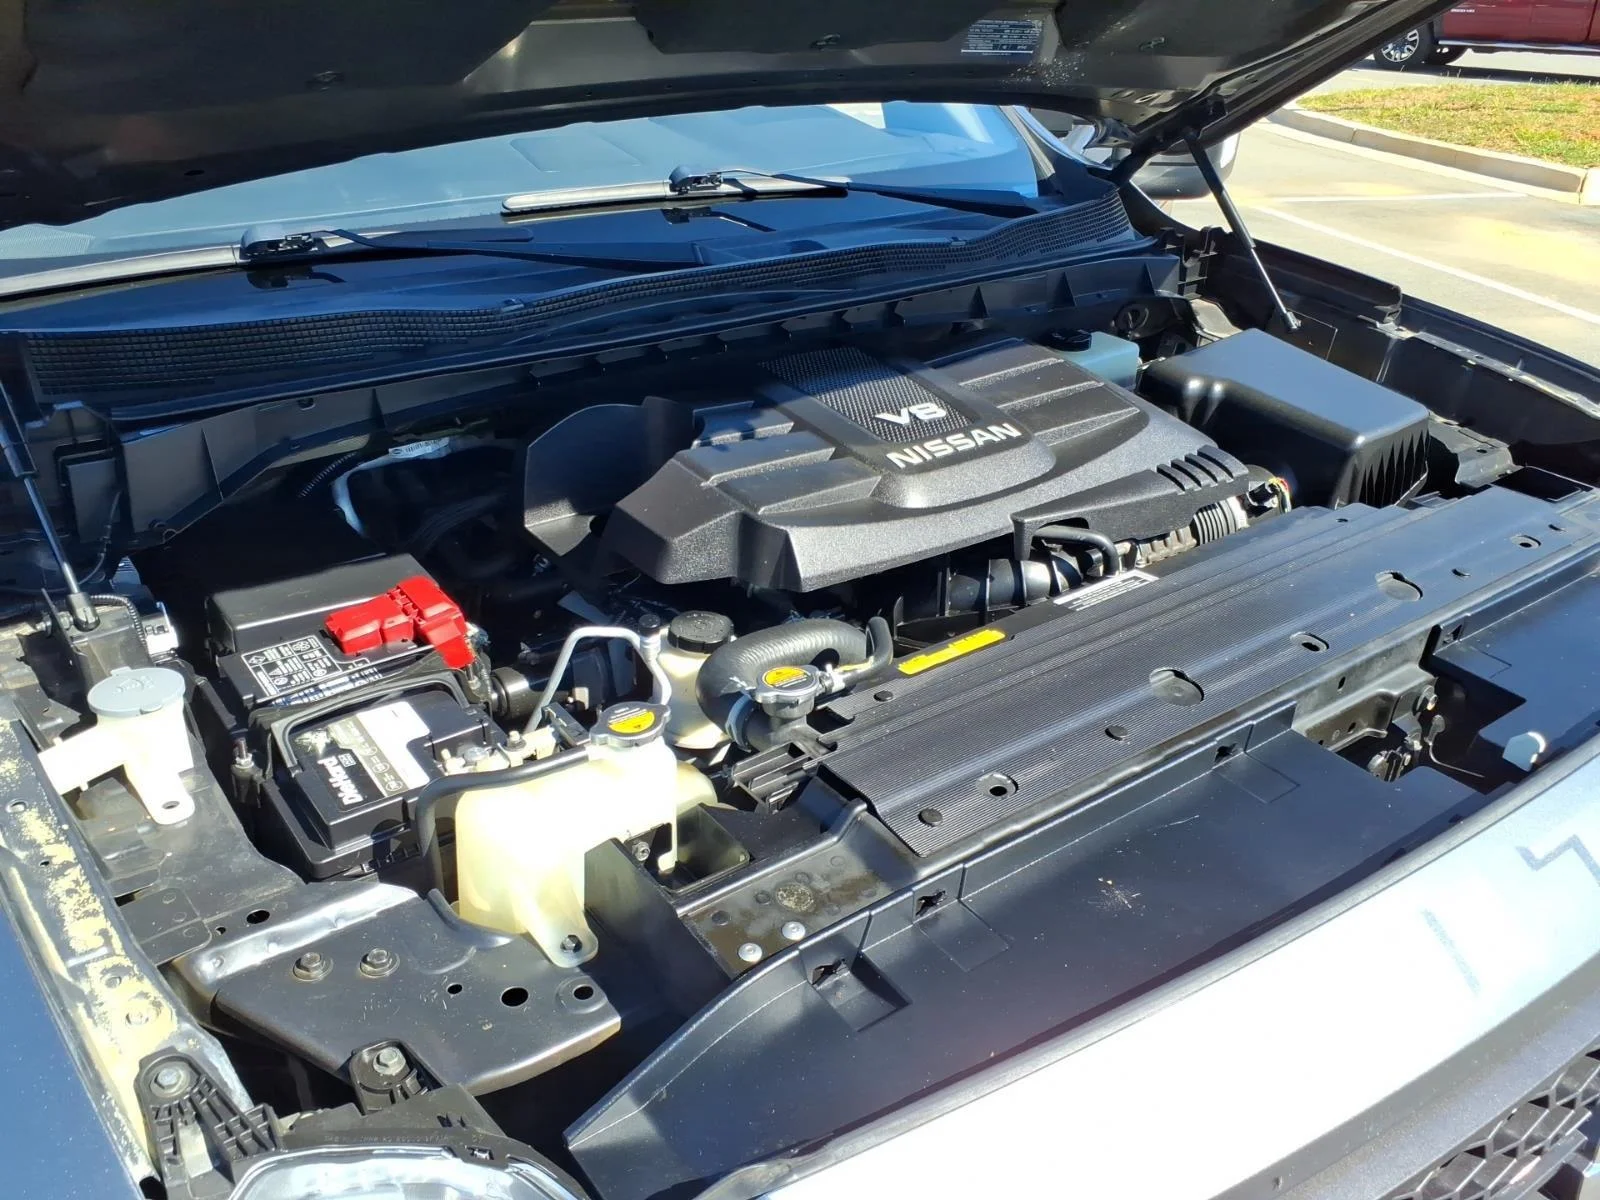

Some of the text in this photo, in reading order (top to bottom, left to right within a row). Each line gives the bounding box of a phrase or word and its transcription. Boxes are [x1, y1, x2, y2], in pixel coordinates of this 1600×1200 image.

[875, 402, 947, 425] V8
[886, 422, 1022, 469] NISSAN
[317, 755, 364, 805] DieHard
